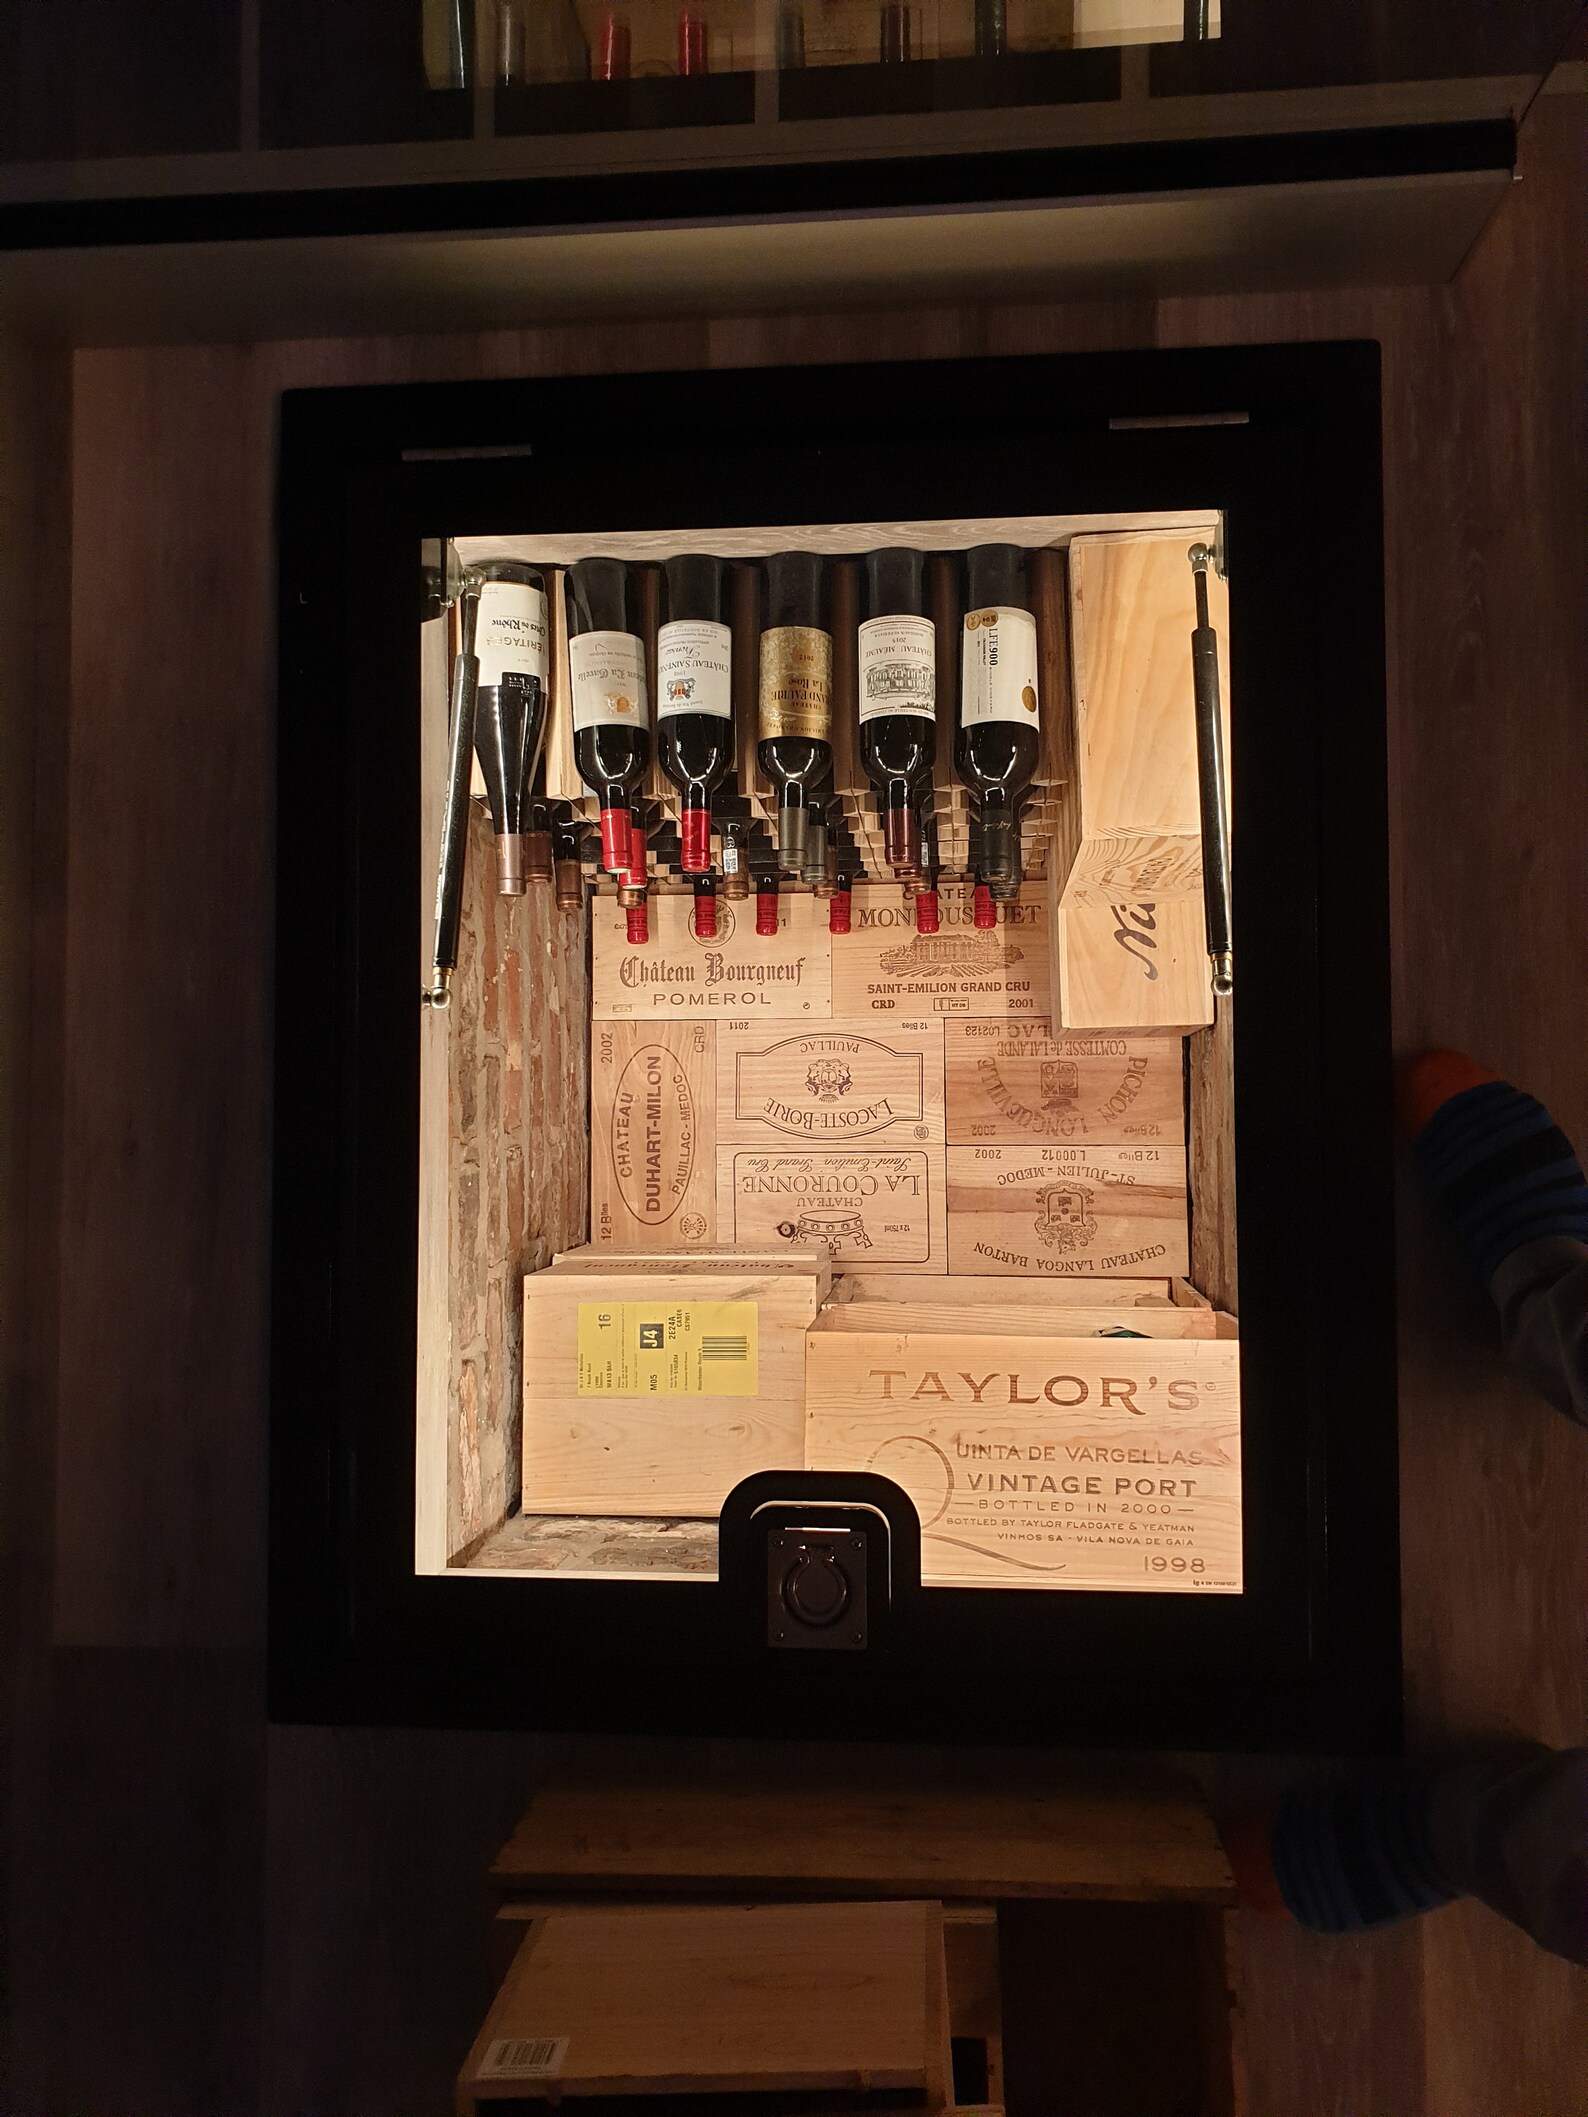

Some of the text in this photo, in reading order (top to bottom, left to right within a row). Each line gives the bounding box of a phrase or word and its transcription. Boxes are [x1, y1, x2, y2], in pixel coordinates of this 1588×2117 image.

[492, 619, 521, 631] Rhône
[799, 654, 815, 662] 2012
[788, 678, 823, 692] La Rose
[619, 952, 806, 989] Château Bourgneuf
[868, 981, 1030, 994] SAINT-EMILION GRAND CRU
[653, 992, 771, 1006] POMEROL
[871, 999, 896, 1009] CRD
[1008, 998, 1034, 1008] 2001
[729, 1021, 749, 1030] 2011
[920, 1022, 928, 1030] 12
[965, 1025, 1000, 1036] L02123
[600, 1032, 614, 1064] 2002
[695, 1026, 705, 1053] CRD
[799, 1041, 860, 1053] PAUILLAC
[996, 1040, 1127, 1058] COMTESSE de LALANDE
[673, 1074, 691, 1120] MEDOC
[1096, 1056, 1148, 1124] PICHON
[763, 1097, 894, 1130] LACOSTE-BORIE
[616, 1091, 635, 1178] CHATEAU
[646, 1056, 662, 1212] DUHART-MILON
[970, 1124, 996, 1136] 2002
[974, 1148, 1002, 1160] 2002
[1146, 1150, 1160, 1161] 12
[671, 1132, 692, 1195] PAUILLAC
[747, 1157, 911, 1173] Saint-Emilion Grand Cru
[996, 1166, 1045, 1186] MEDOC
[741, 1175, 920, 1196] LA COURONNE
[797, 1197, 864, 1207] CHATEAU
[600, 1226, 612, 1240] 12
[973, 1242, 1166, 1272] CHATEAU LANGOA BARTON
[598, 1313, 612, 1330] 16
[642, 1329, 659, 1347] J4
[868, 1369, 1201, 1416] TAYLOR'S
[1028, 1447, 1056, 1462] DE
[1065, 1445, 1204, 1467] VARGELLAS
[967, 1472, 1198, 1498] VINTAGE PORT
[979, 1498, 1172, 1515] BOTTLED IN 2000
[946, 1517, 1196, 1533] BOTTLED BY TAYLOR FLADGATE & YEATMAN
[997, 1531, 1195, 1547] VINHOS SA VILA NOVA DE GAIA
[1143, 1555, 1206, 1573] 1998
